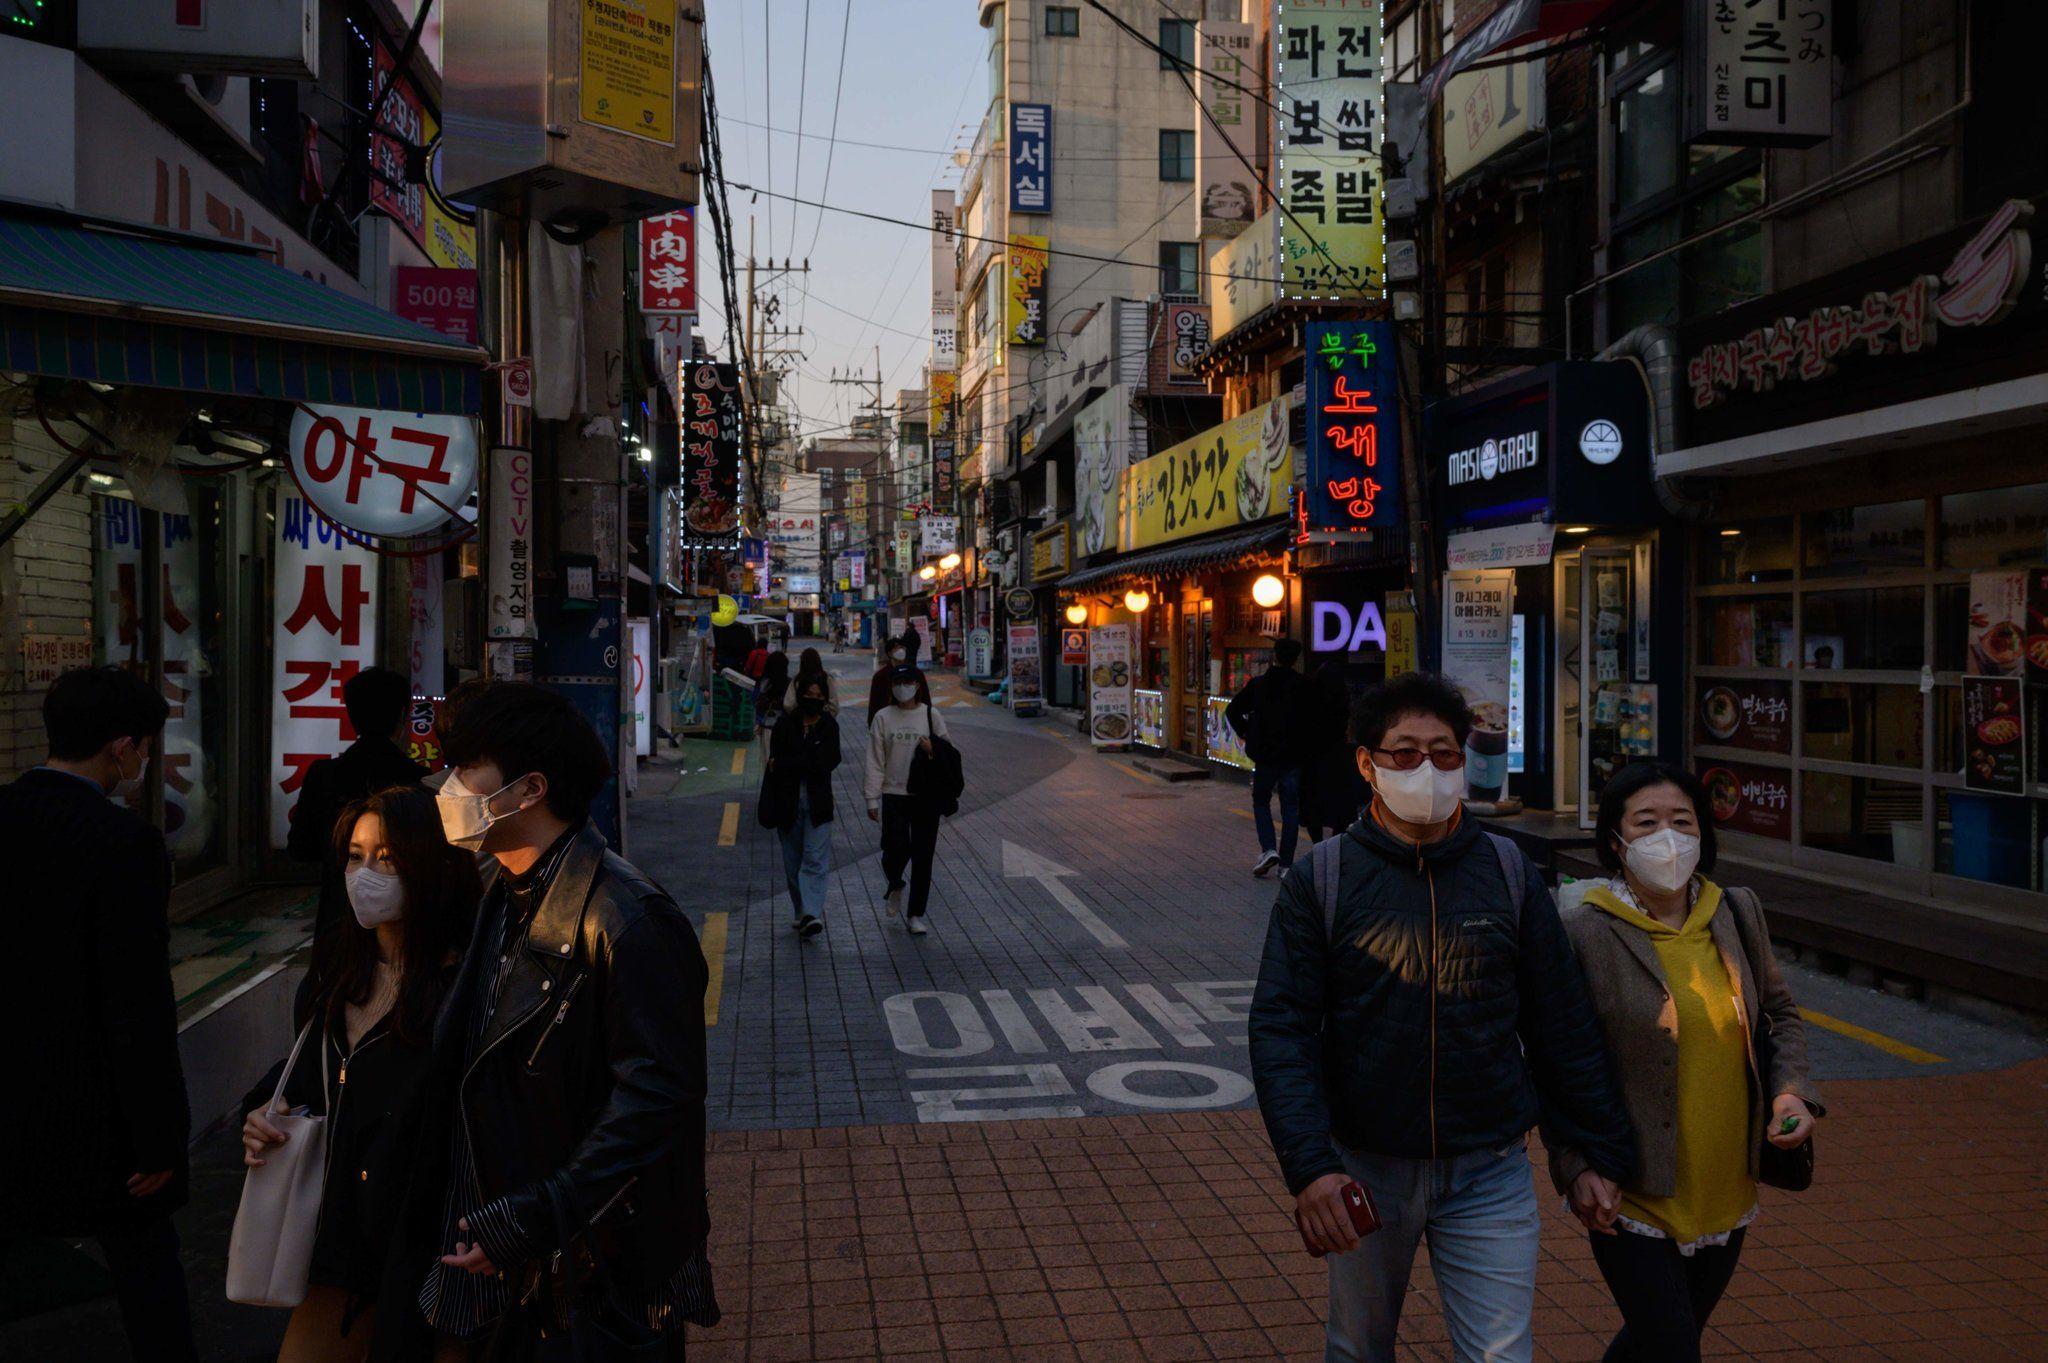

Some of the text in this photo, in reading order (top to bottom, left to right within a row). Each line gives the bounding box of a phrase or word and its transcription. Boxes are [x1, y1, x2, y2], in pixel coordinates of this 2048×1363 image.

[1288, 25, 1374, 78] 파전
[1715, 64, 1729, 121] 신촌점
[1288, 99, 1375, 151] 보쌈
[1015, 107, 1046, 208] 독서실
[1290, 170, 1376, 224] 족발
[406, 283, 475, 309] 500원
[303, 415, 452, 516] 야구
[1323, 375, 1382, 518] 노래방
[1449, 431, 1539, 486] MASI GRAY
[1158, 436, 1229, 533] 김삿갓
